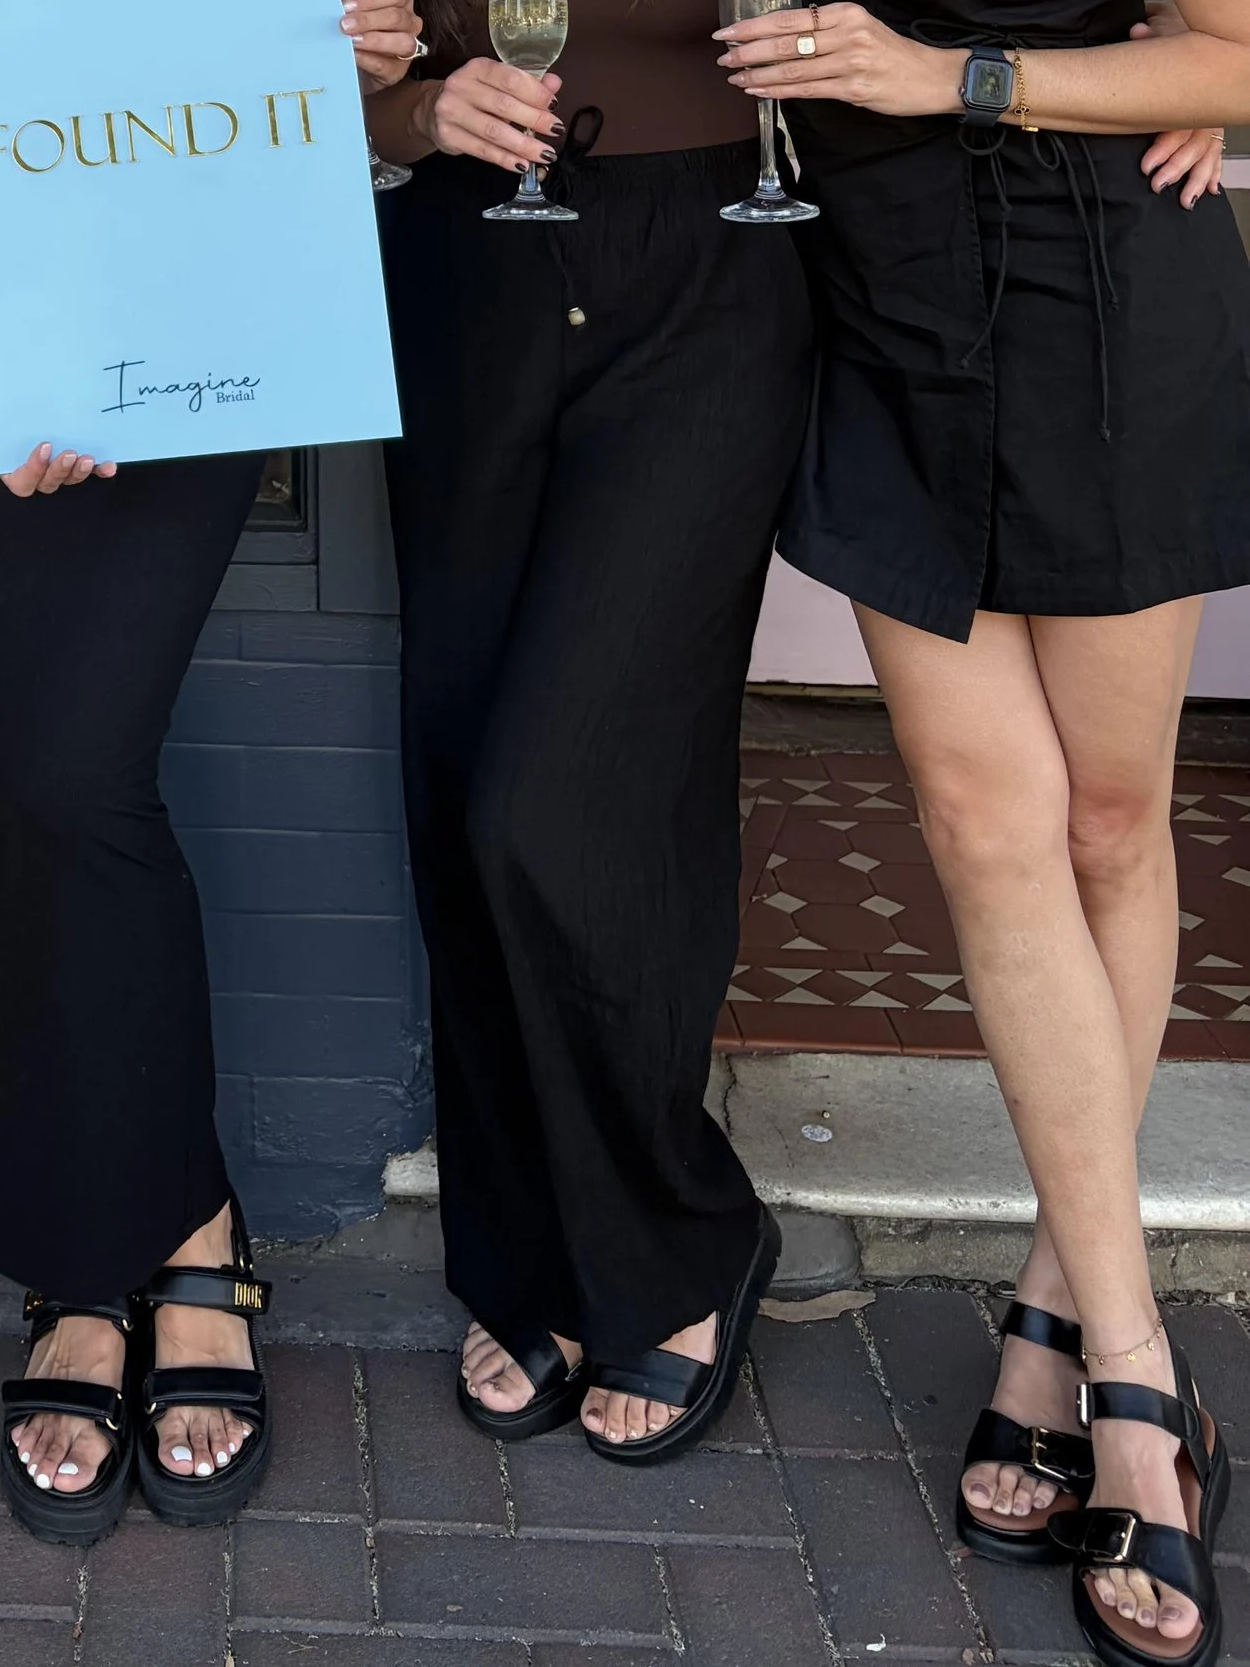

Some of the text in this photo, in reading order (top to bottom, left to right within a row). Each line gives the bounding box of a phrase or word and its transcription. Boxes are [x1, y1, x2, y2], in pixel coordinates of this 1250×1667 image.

[262, 86, 325, 148] IT
[101, 360, 261, 414] Imagine
[216, 389, 256, 404] Bridal
[234, 1282, 263, 1309] DIOR
